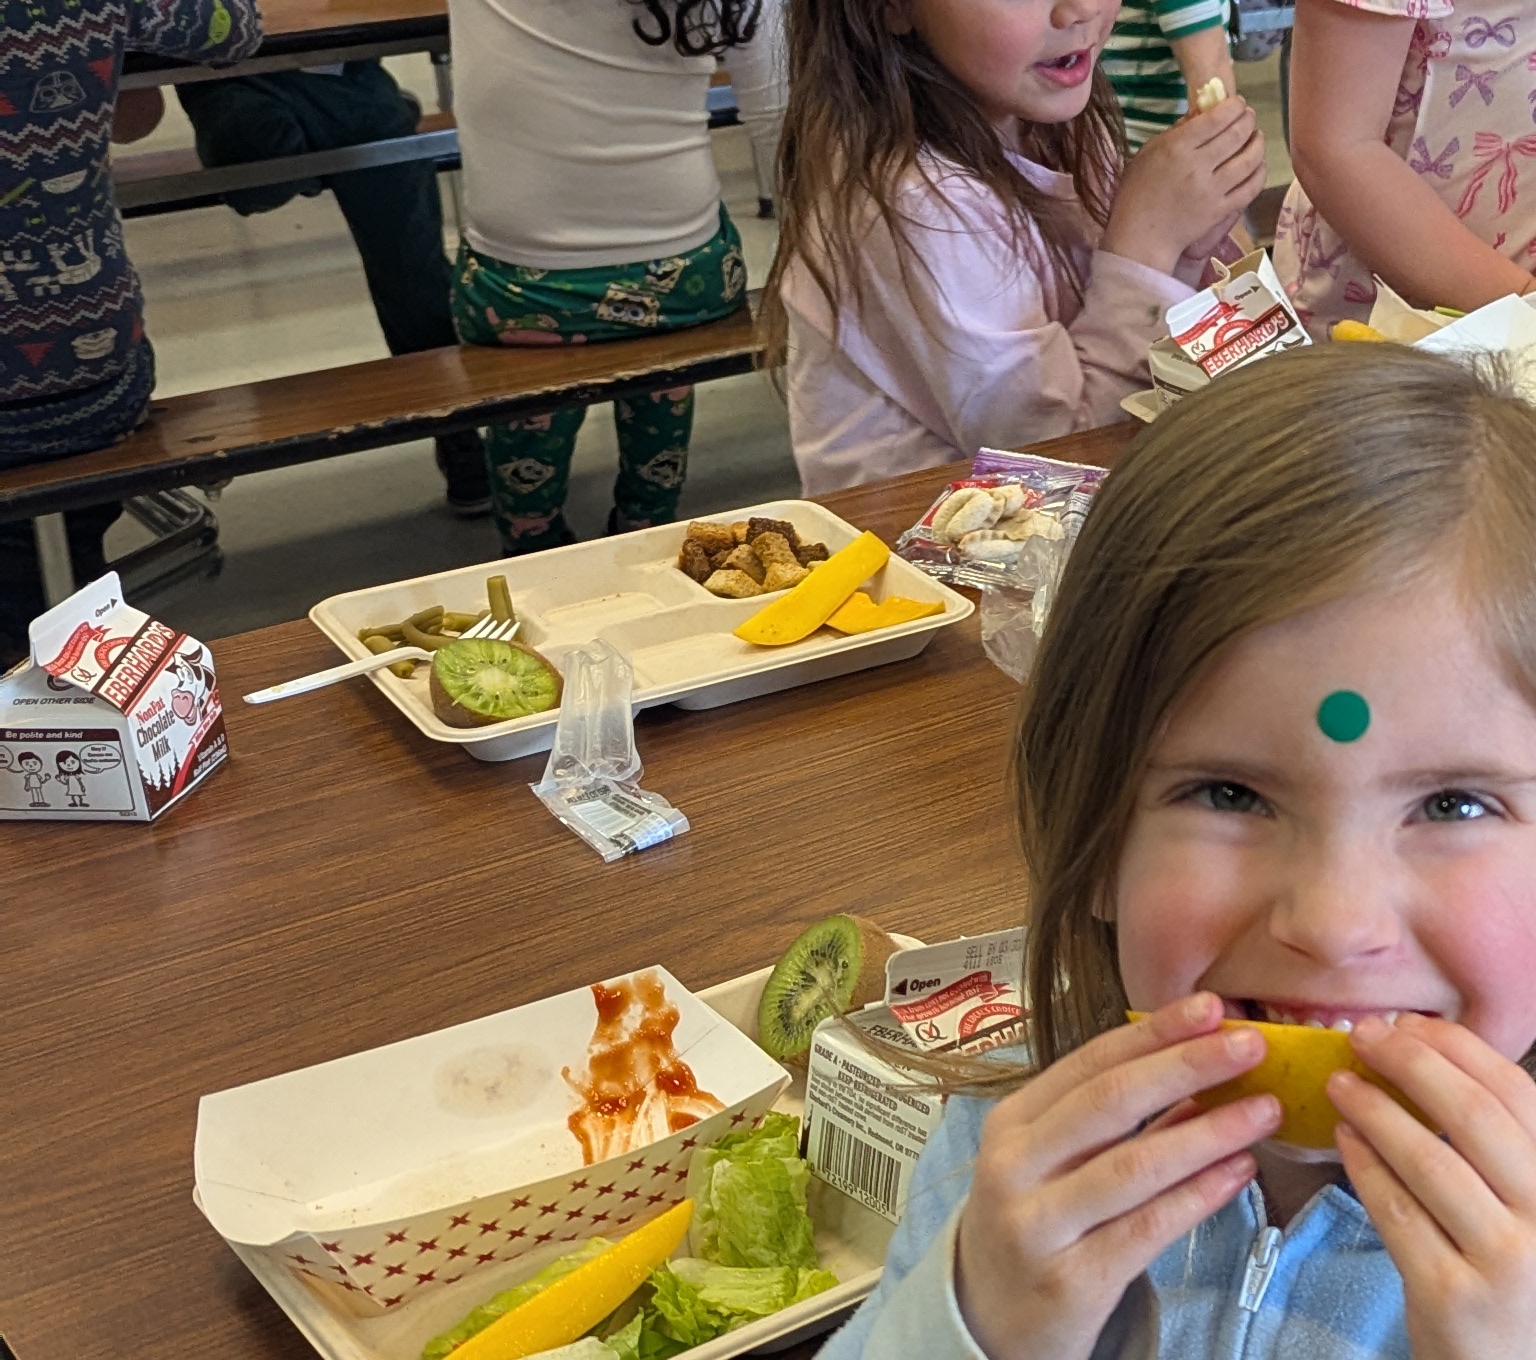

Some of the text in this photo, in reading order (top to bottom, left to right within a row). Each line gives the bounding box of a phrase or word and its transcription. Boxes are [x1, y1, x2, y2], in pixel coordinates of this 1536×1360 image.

[1202, 311, 1289, 378] EBERHARD'S
[99, 620, 176, 708] EBERHARD'S
[13, 696, 96, 706] OPEN OTHER SIDE
[20, 731, 44, 740] polite
[46, 731, 62, 739] and
[64, 731, 83, 739] kind
[136, 710, 176, 748] Chocolate
[151, 736, 172, 763] Milk
[910, 977, 941, 992] Open
[825, 1168, 855, 1194] 72199
[858, 1190, 888, 1216] 12005
